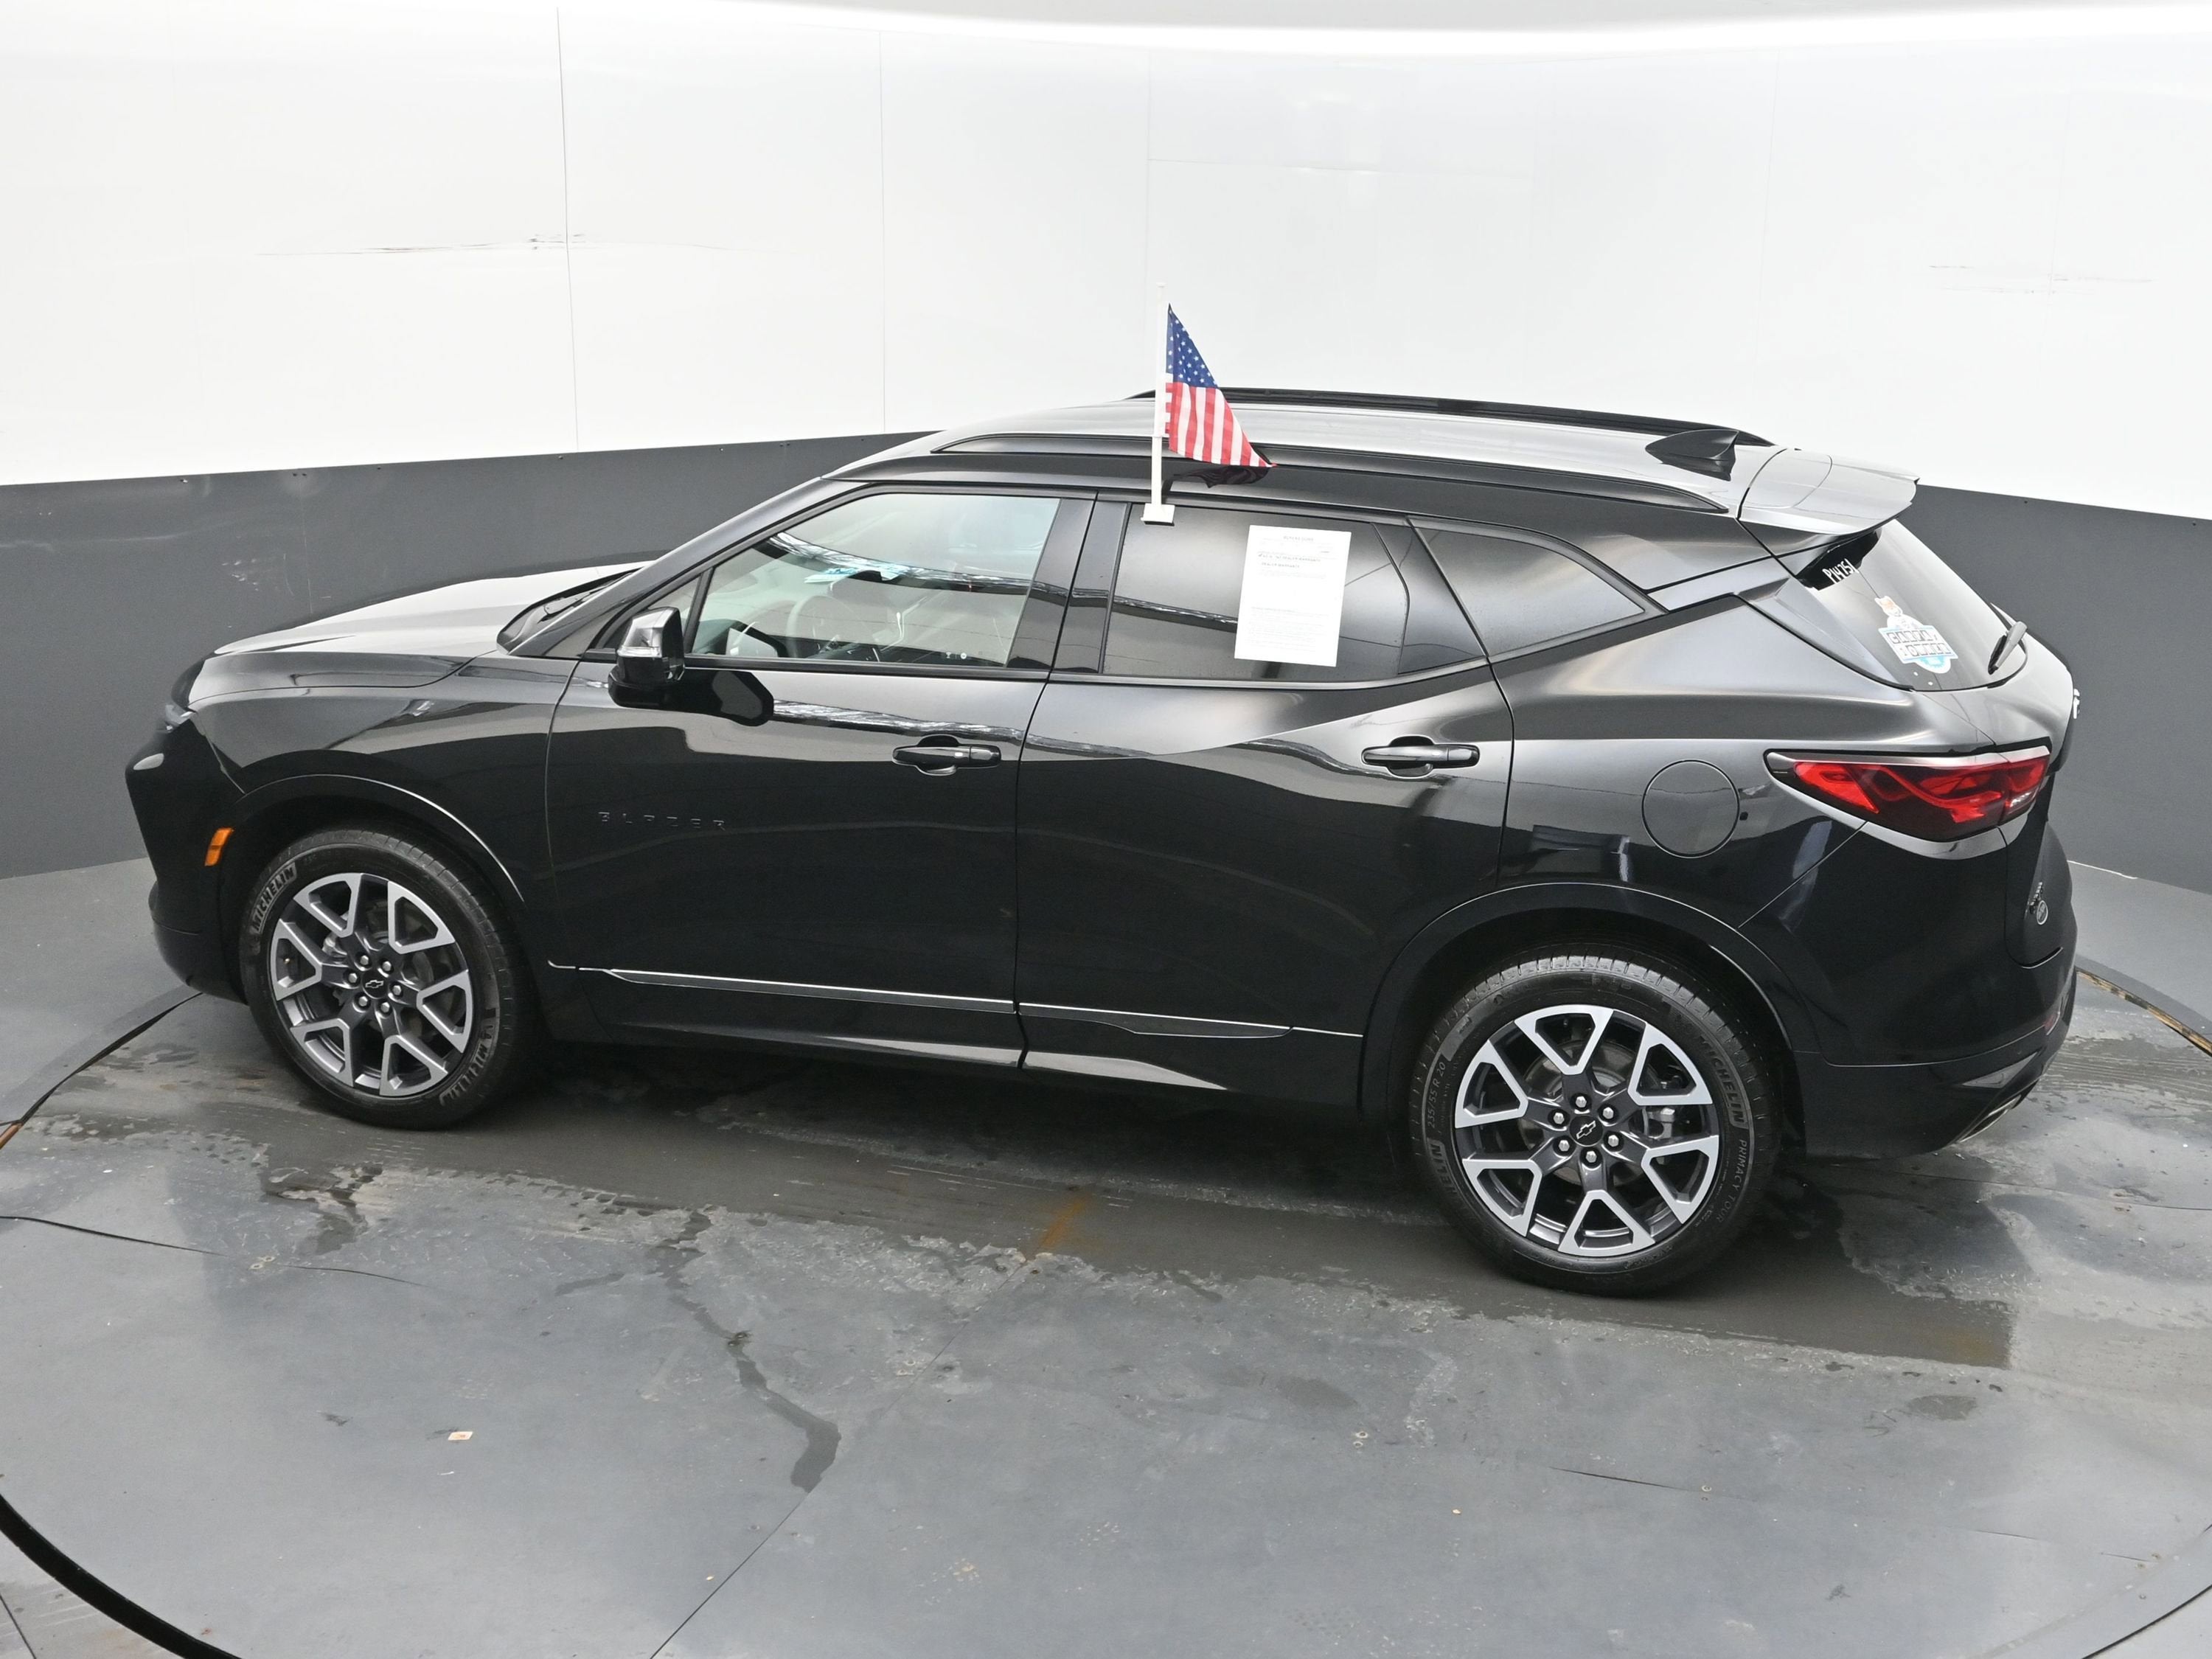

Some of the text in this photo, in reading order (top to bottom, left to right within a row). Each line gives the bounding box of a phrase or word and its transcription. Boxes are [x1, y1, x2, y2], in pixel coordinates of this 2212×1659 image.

[1822, 558, 1859, 584] P14751
[251, 866, 294, 932] MICHELIN
[1427, 1061, 1446, 1129] 235/55 R 20
[1700, 1035, 1745, 1123] MICHELIN
[1731, 1138, 1747, 1192] PRIMACY
[1716, 1195, 1736, 1223] TOUR
